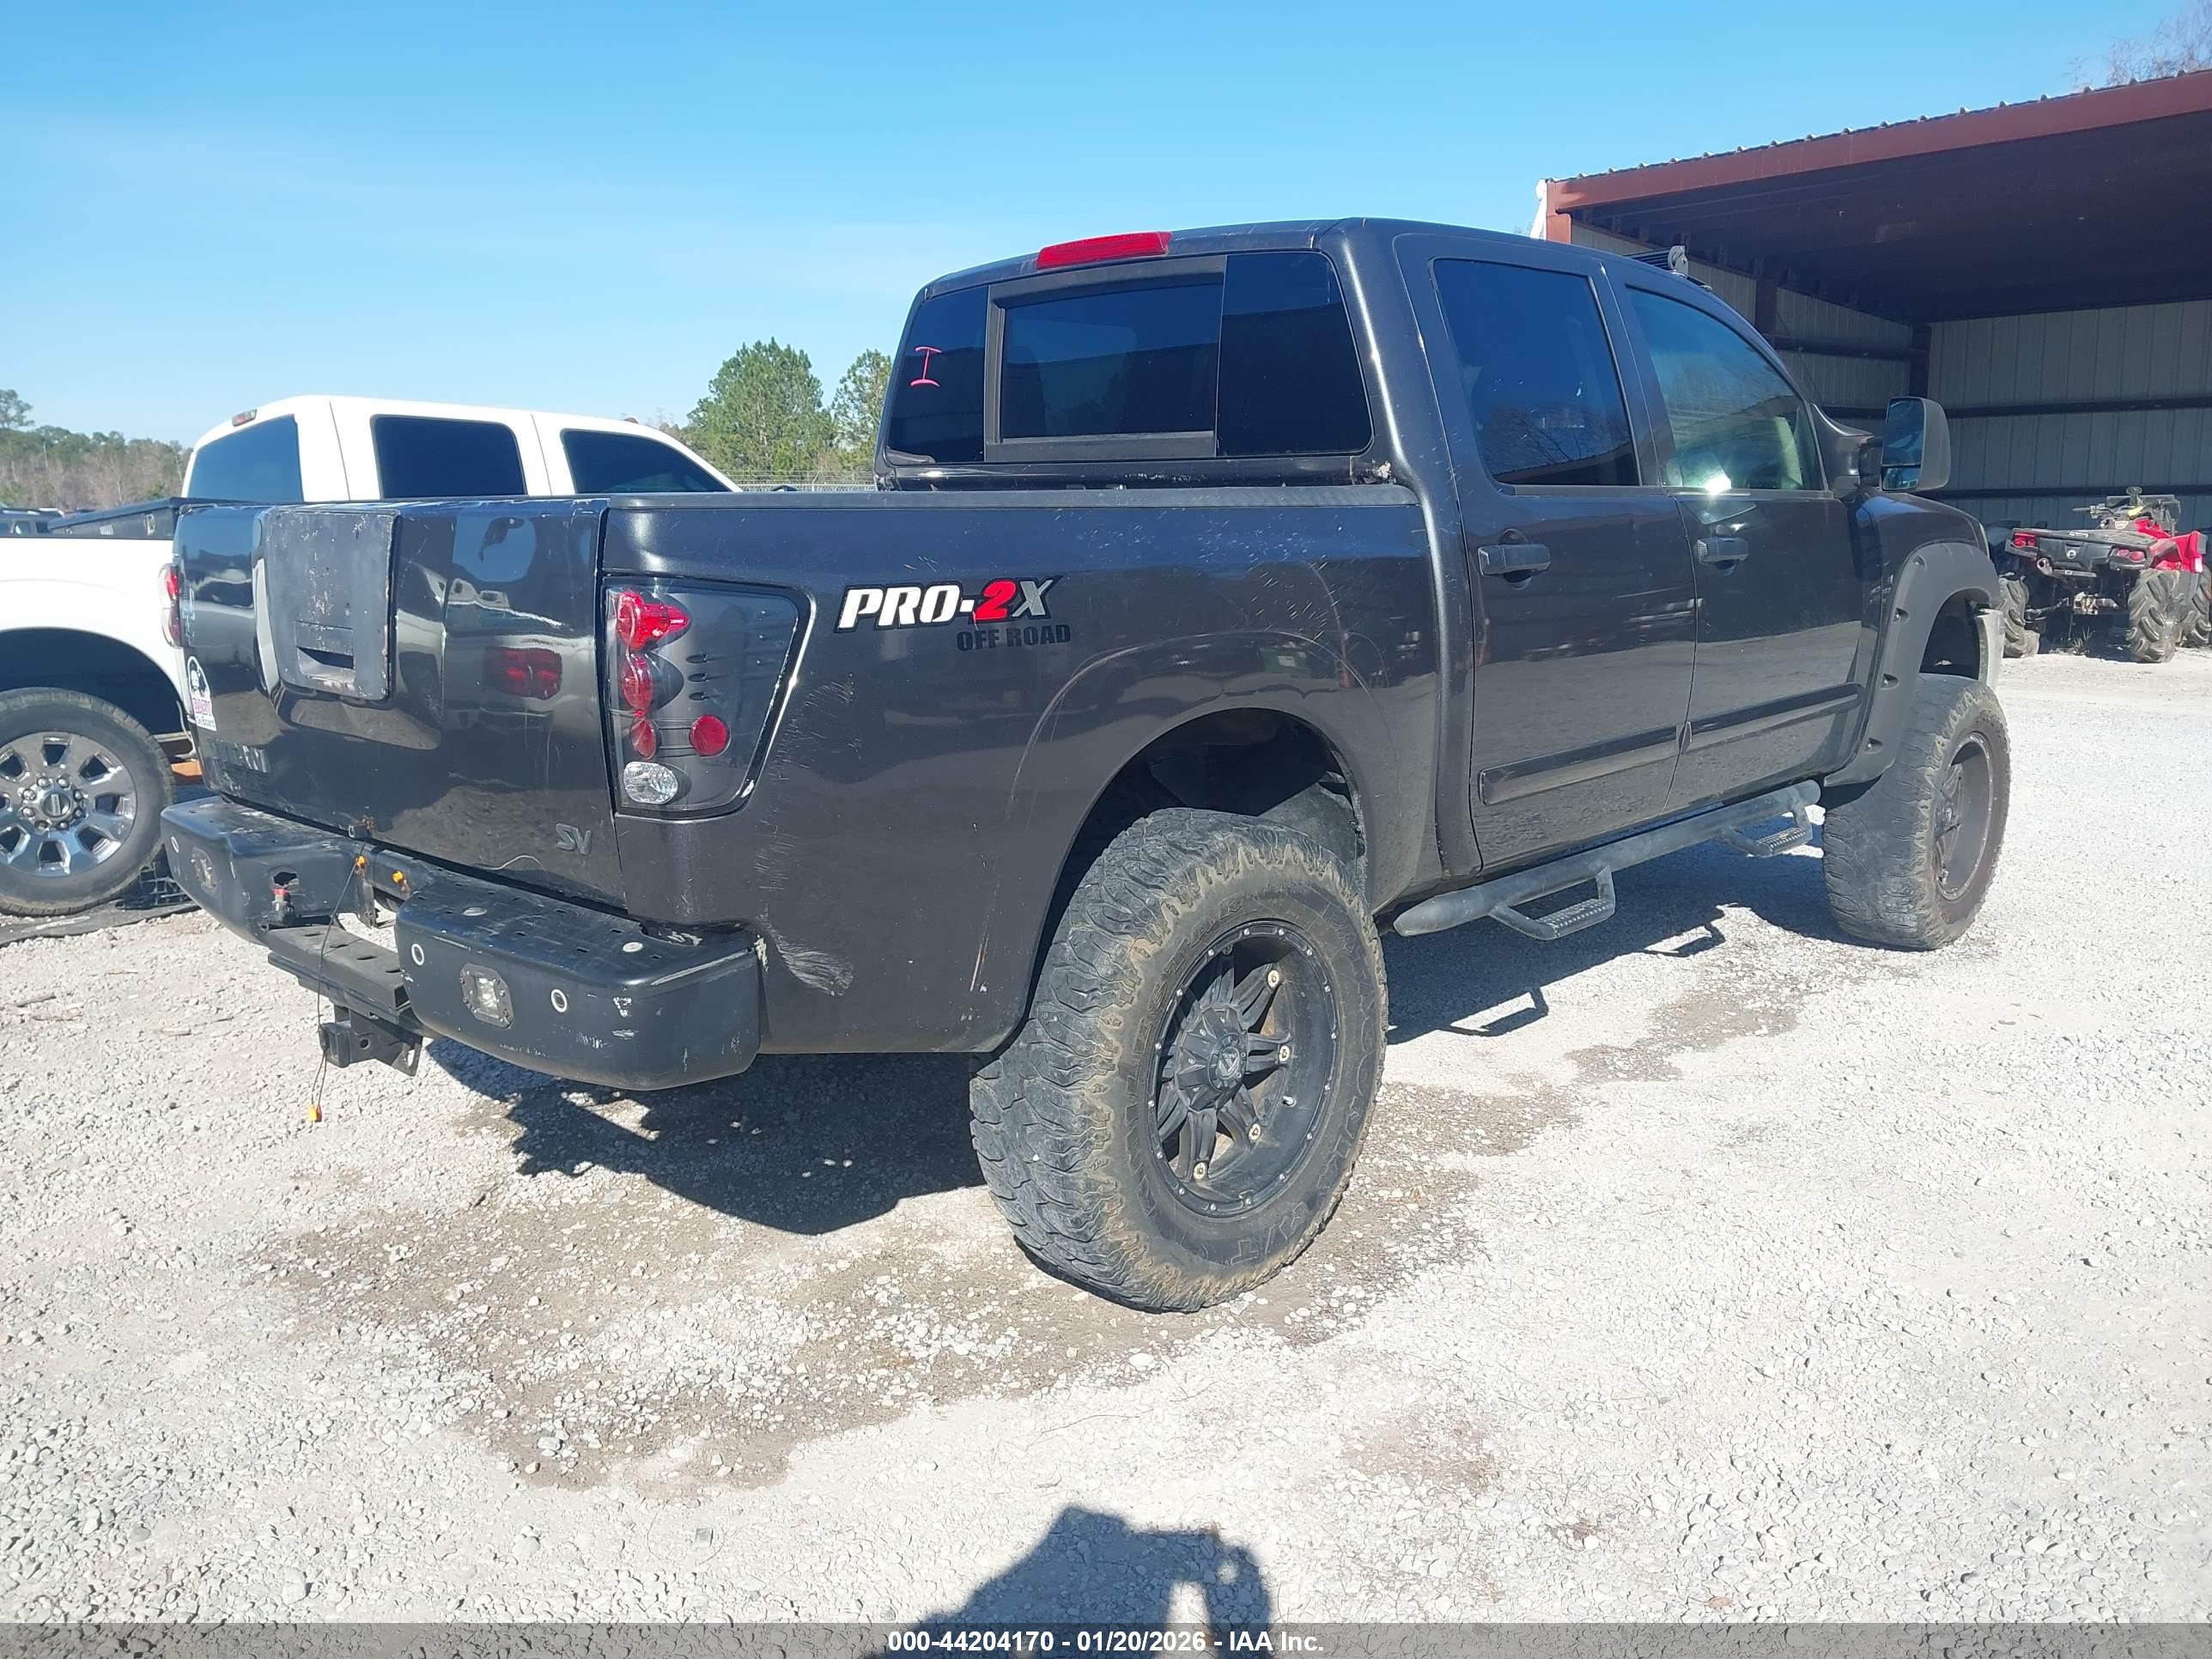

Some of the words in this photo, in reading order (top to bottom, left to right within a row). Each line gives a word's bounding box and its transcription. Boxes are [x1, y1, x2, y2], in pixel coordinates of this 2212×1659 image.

[834, 576, 1062, 633] PRO-2X
[957, 629, 1000, 651] OFF
[1006, 624, 1071, 647] ROAD
[555, 823, 592, 855] SV
